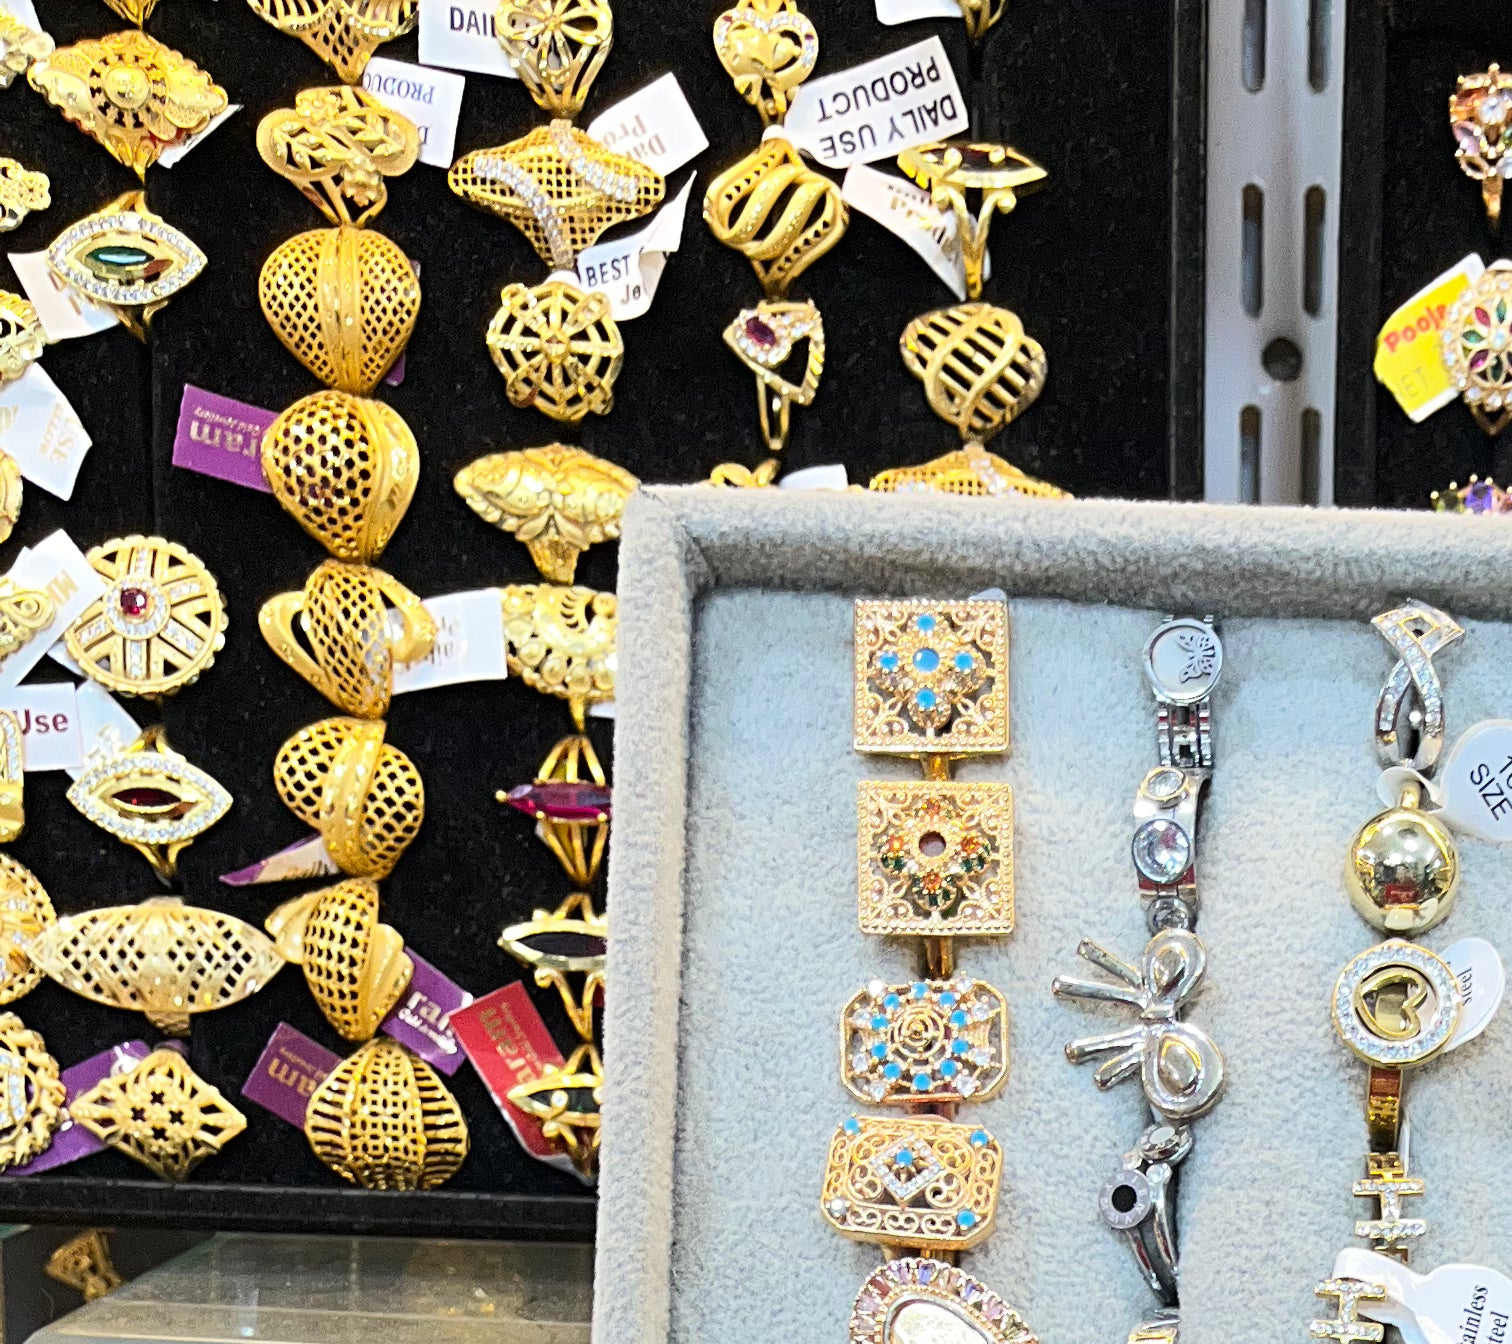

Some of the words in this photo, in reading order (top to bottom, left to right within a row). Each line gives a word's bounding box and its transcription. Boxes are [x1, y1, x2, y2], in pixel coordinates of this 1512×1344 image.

[816, 55, 942, 123] PRODUCT
[888, 93, 958, 143] DAILY
[820, 123, 877, 160] USE
[585, 253, 632, 288] BEST
